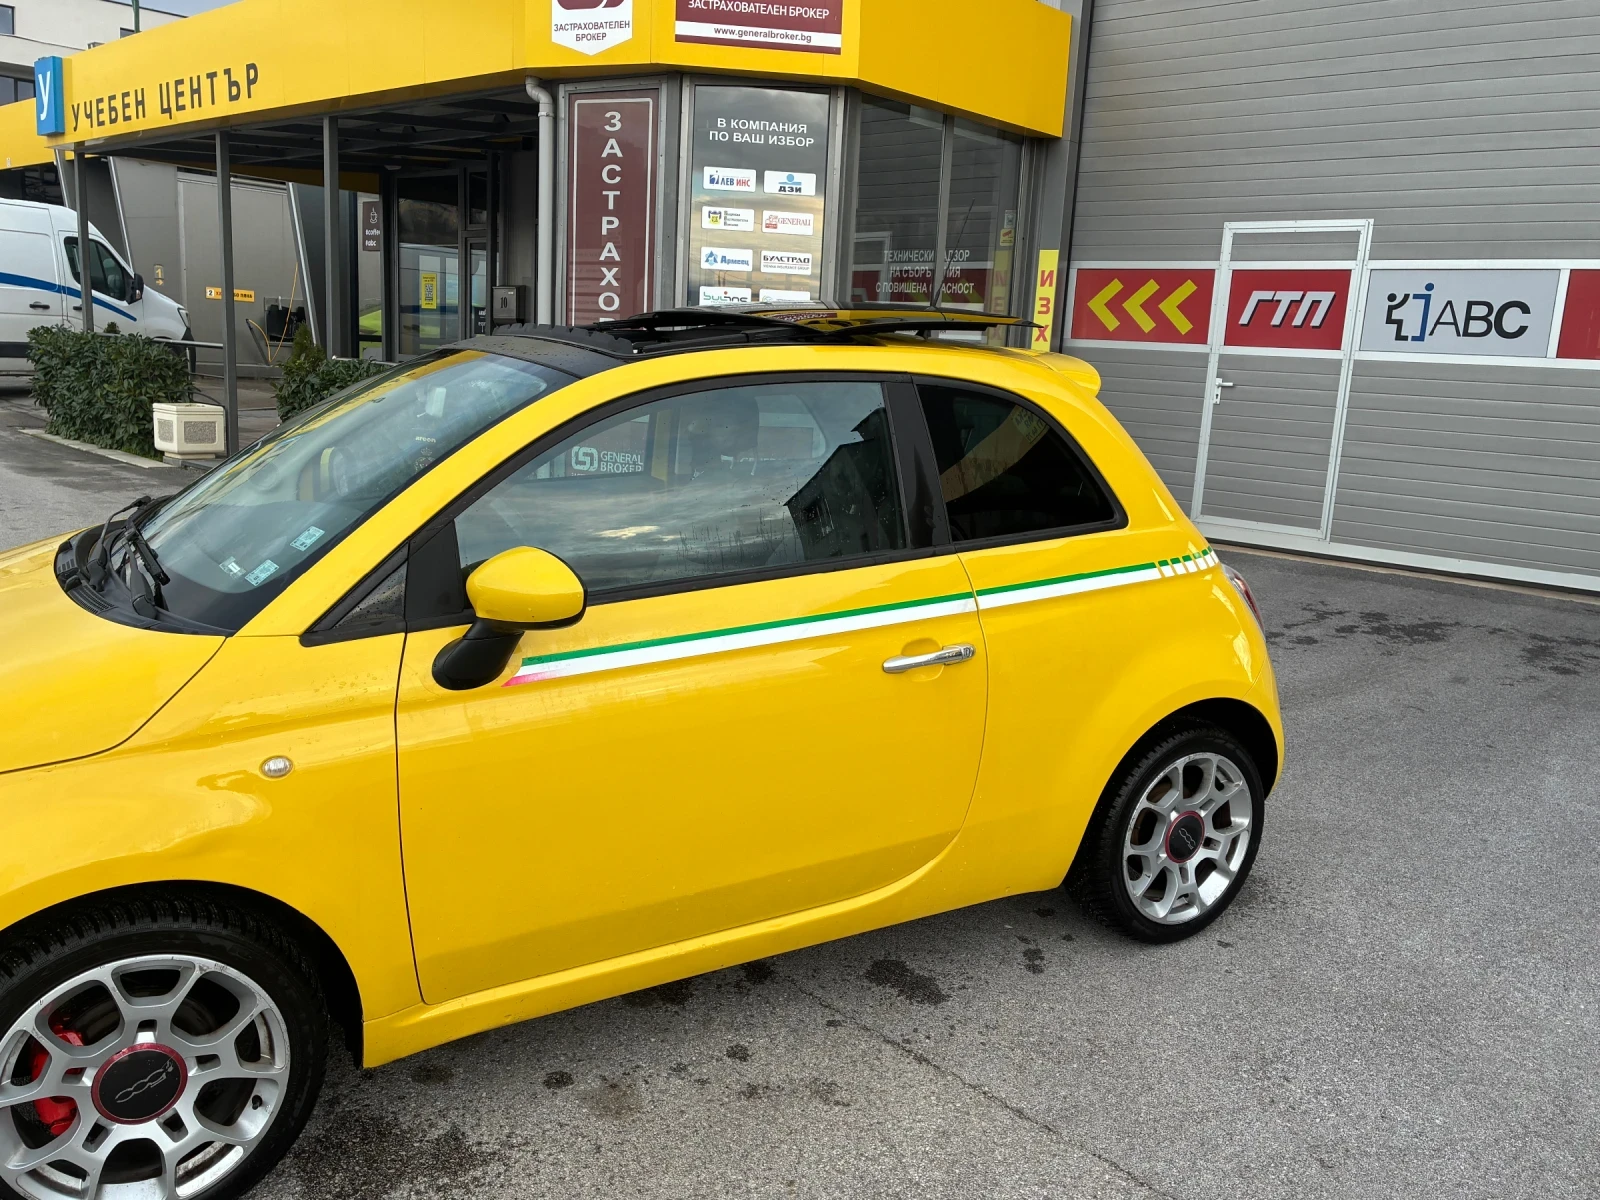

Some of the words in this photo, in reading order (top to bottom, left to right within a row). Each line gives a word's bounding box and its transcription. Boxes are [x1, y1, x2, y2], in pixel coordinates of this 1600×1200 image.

[688, 0, 787, 17] ЗАСТРАХОВАТЕЛЕН
[789, 7, 830, 19] БРОКЕР
[553, 20, 631, 32] ЗАСТРАХОВАТЕЛЕН
[575, 32, 607, 42] БРОКЕР
[714, 27, 812, 43] www.generalbroker.bg
[71, 87, 146, 132] УЧЕБЕН
[159, 62, 259, 120] ЦЕНТЪР
[717, 118, 727, 128] В
[730, 119, 807, 134] КОМПАНИЯ
[709, 131, 729, 141] ПО
[733, 132, 765, 144] ВАШ
[768, 135, 815, 147] ИЗБОР
[720, 177, 735, 186] ЛЕВ
[736, 178, 751, 188] ИНС
[778, 185, 802, 194] ДЗИ
[598, 111, 624, 323] ЗАСТРАХО
[777, 217, 811, 226] GENERALI
[884, 250, 935, 262] ТЕХНИЧЕСКИ
[890, 266, 901, 277] НА
[882, 282, 928, 293] ПОВИШЕНА
[500, 296, 508, 309] 10
[1238, 291, 1336, 328] ГТП
[600, 451, 644, 465] GENERAL
